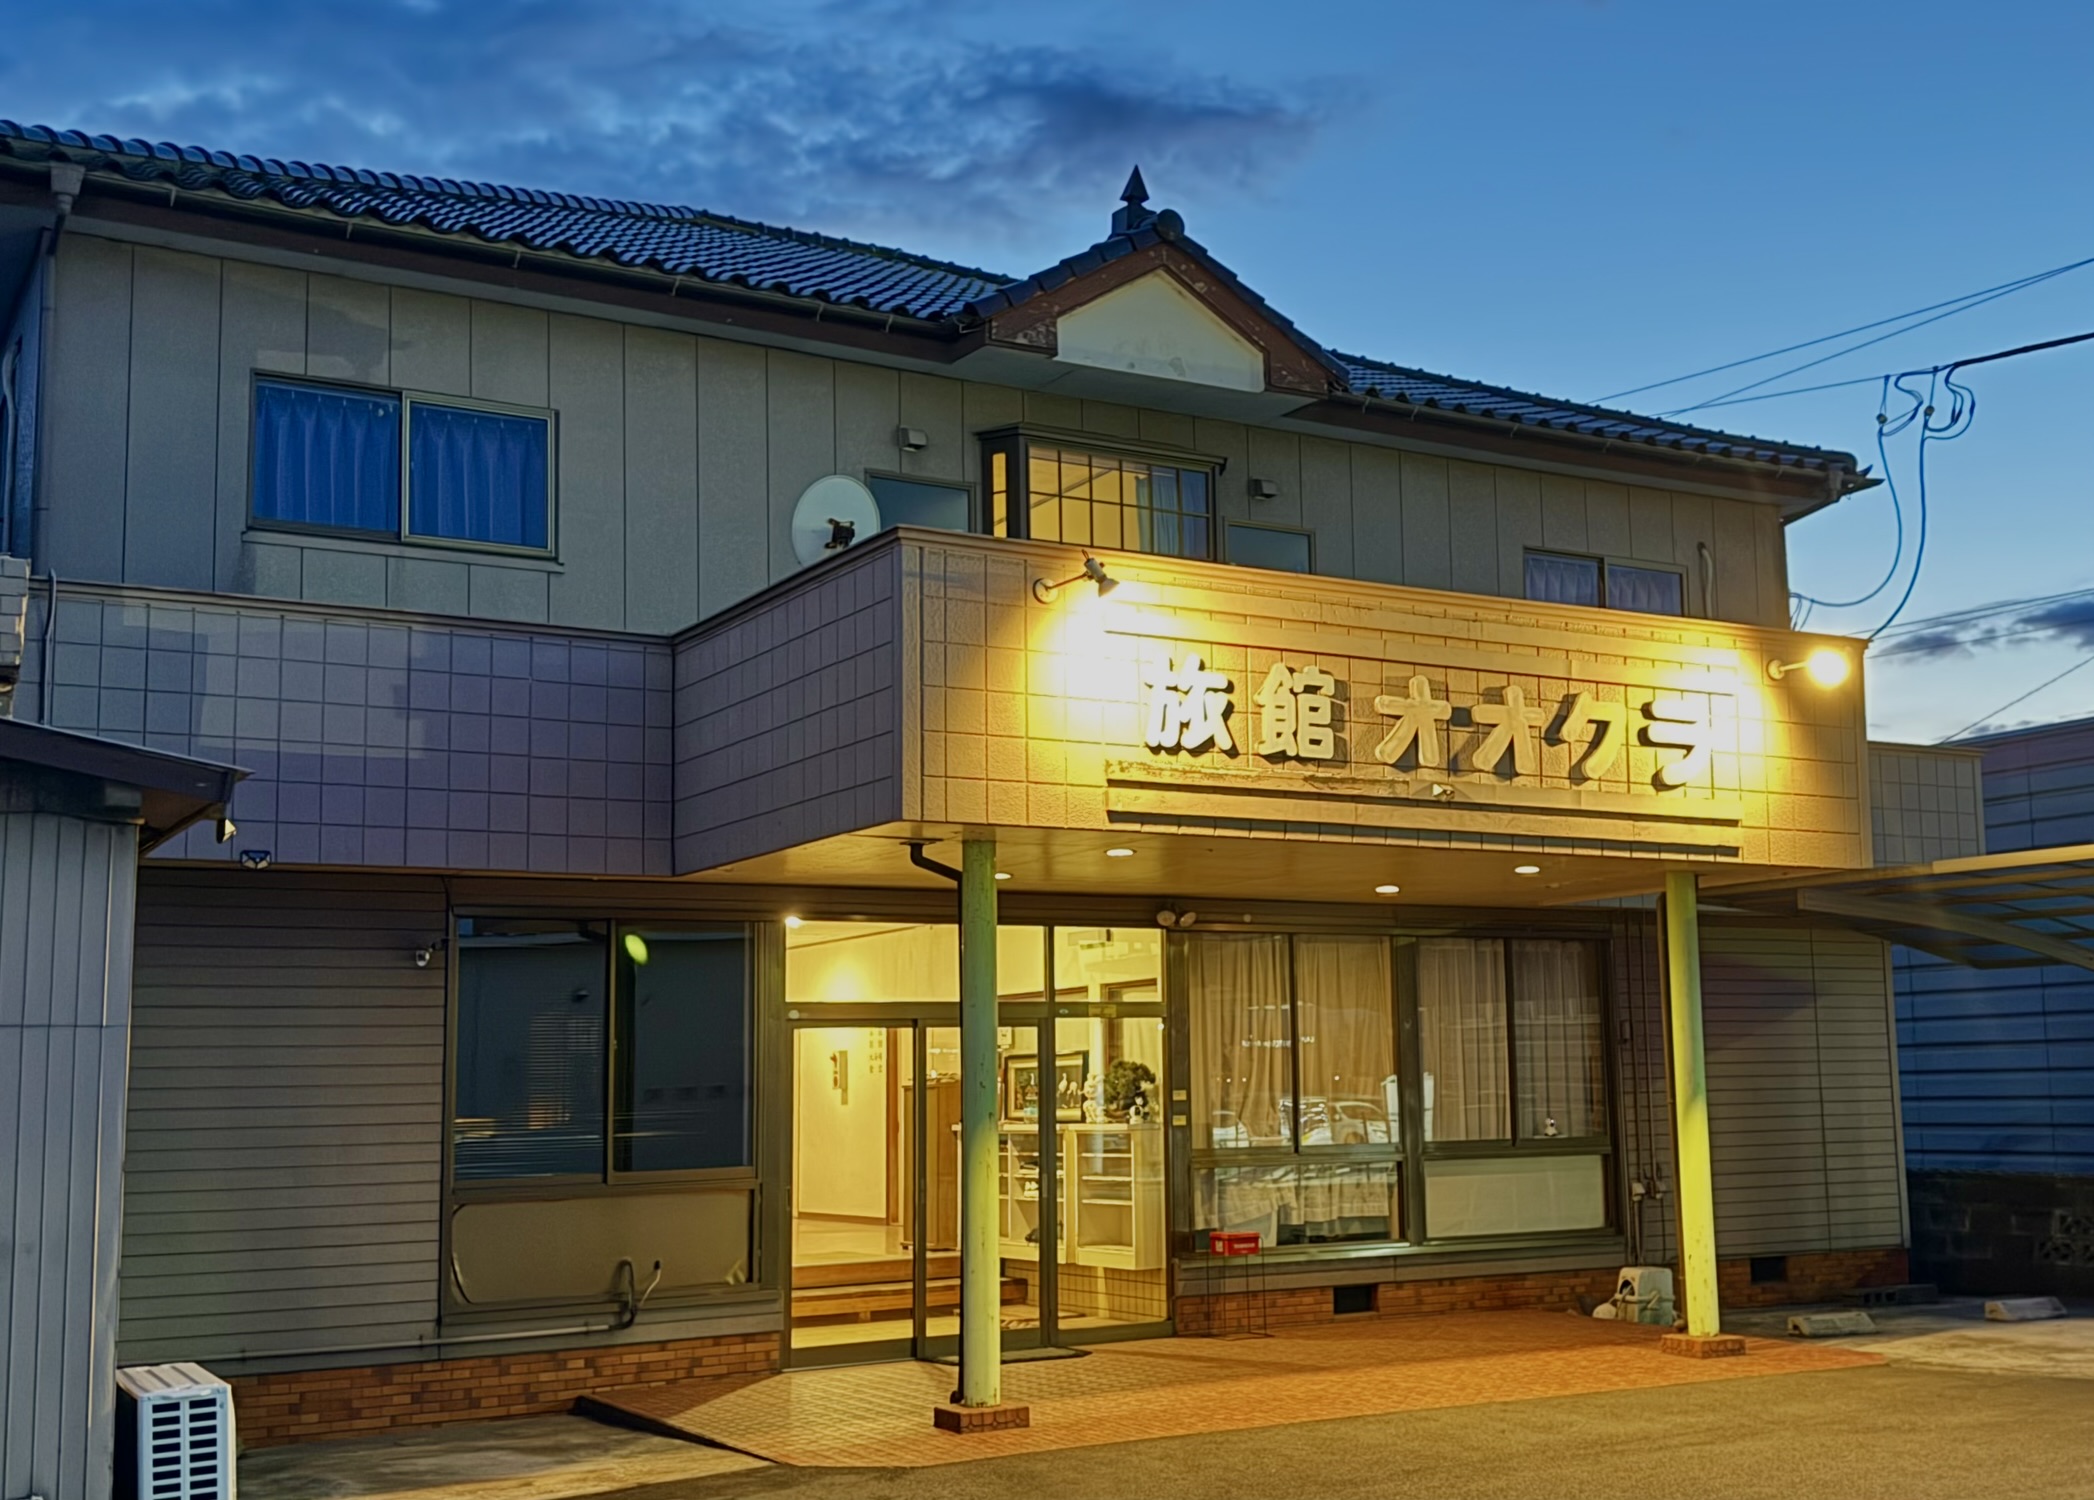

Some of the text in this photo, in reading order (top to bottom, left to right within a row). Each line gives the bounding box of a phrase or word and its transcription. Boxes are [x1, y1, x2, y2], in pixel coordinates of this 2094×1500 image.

[1143, 652, 1713, 787] 旅館オオクラ
